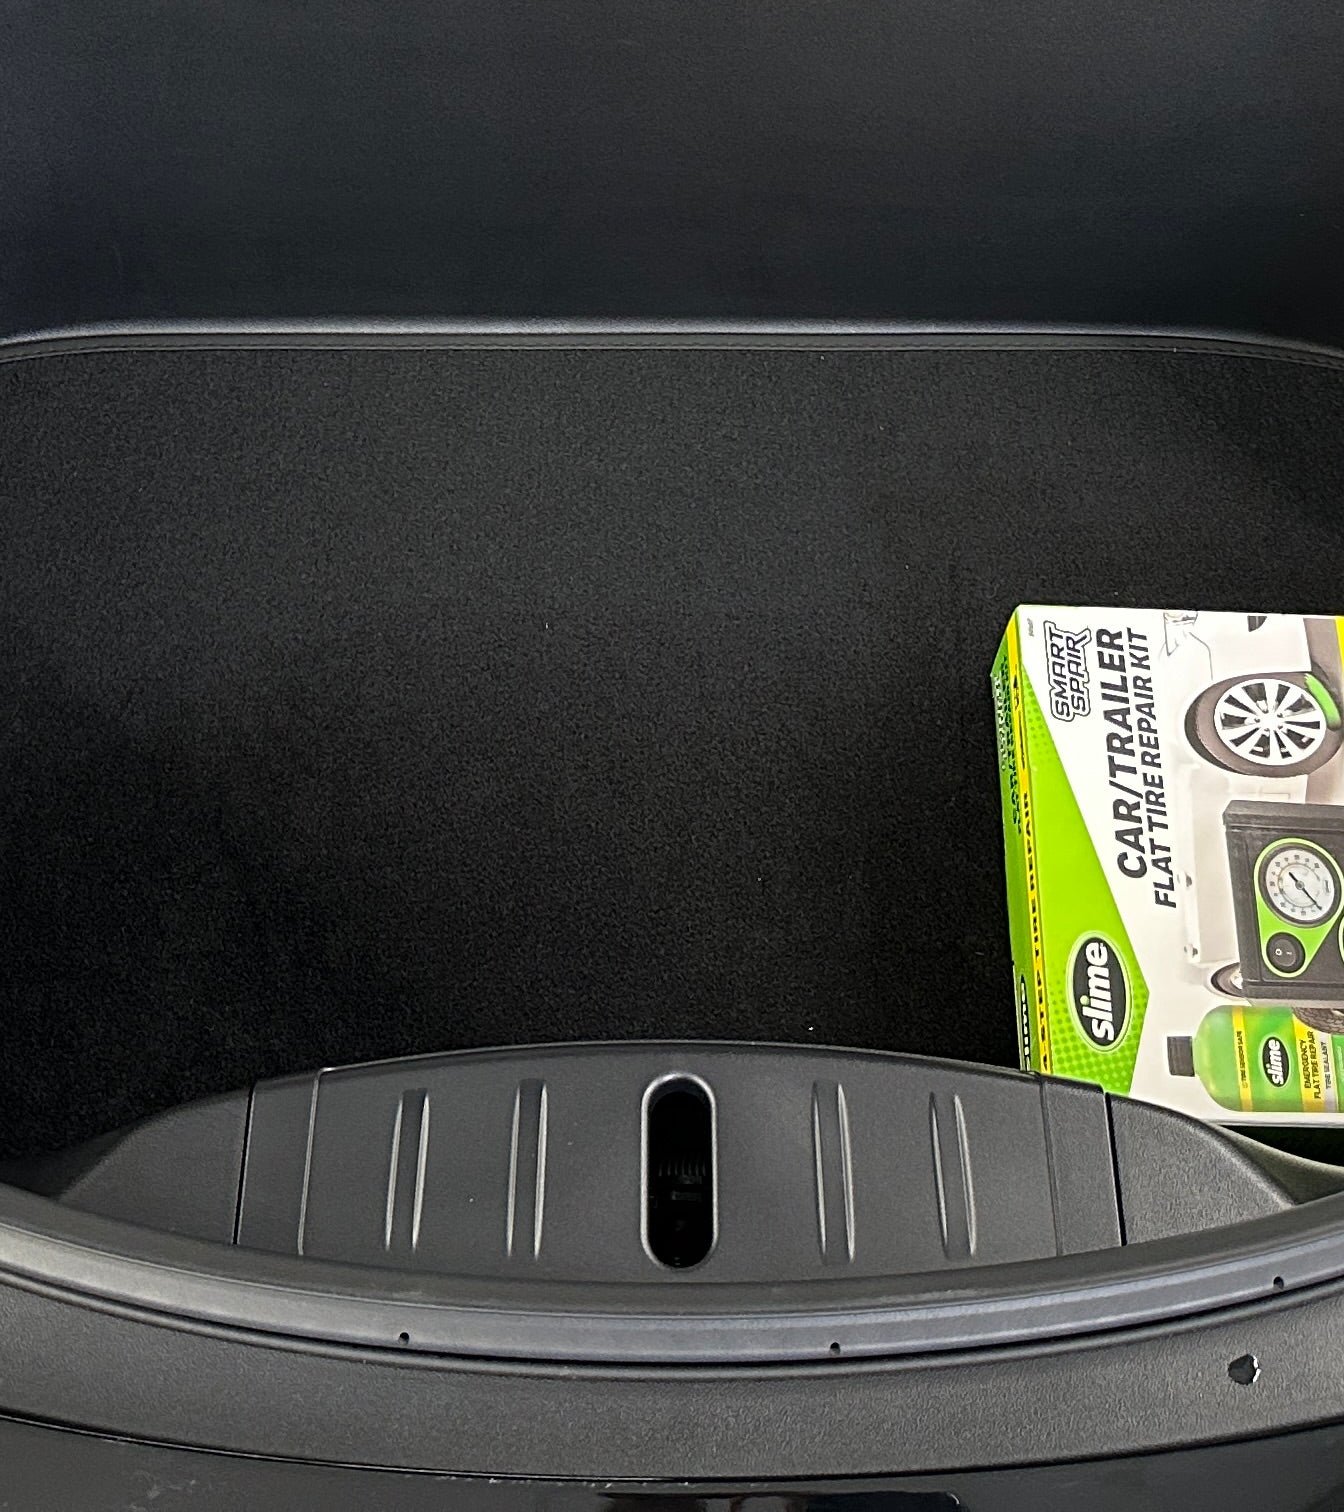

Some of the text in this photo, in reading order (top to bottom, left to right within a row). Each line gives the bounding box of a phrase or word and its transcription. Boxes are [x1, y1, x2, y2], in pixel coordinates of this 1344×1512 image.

[1048, 625, 1070, 717] SMART
[1066, 635, 1087, 712] SPAIR
[1096, 628, 1148, 879] CAR/TRAILER
[1126, 627, 1177, 908] FLAT TIRE REPAIR KIT
[1023, 792, 1035, 892] REPAIR
[1031, 898, 1040, 959] TIRE
[1080, 941, 1115, 1041] slime
[1266, 1039, 1284, 1084] slime
[1299, 1039, 1312, 1088] EMERGENCY
[1307, 1031, 1322, 1099] FLAT TIRE REPAIR
[1320, 1041, 1332, 1089] TIRE SEALANT
